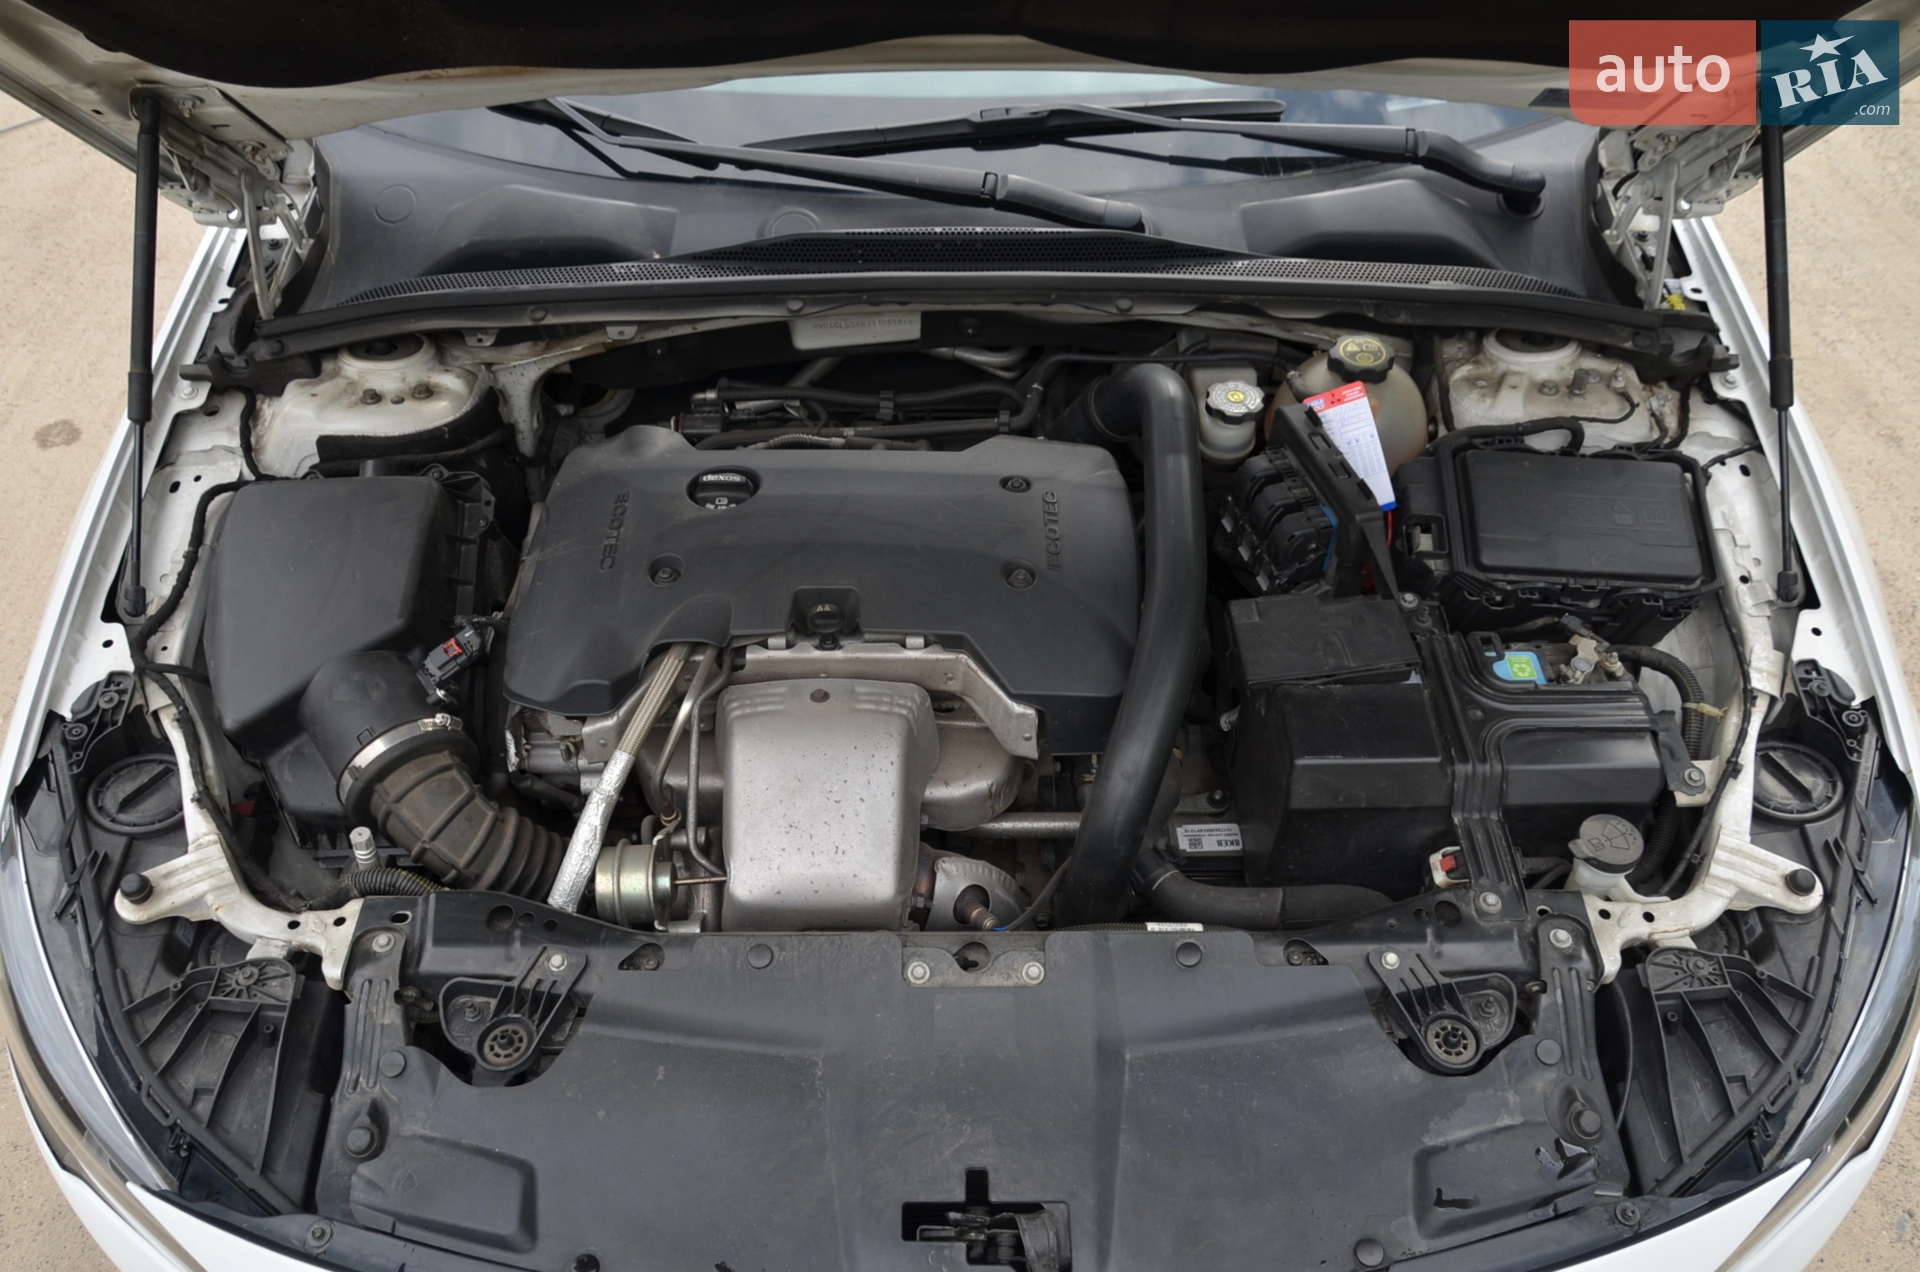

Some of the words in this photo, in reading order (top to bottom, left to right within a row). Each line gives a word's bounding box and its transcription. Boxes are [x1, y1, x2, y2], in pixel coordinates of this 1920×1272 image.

[702, 474, 741, 482] dexos
[600, 491, 630, 571] ECOTEC
[1042, 489, 1061, 570] ECOTEC
[1216, 839, 1241, 848] 8KEB
